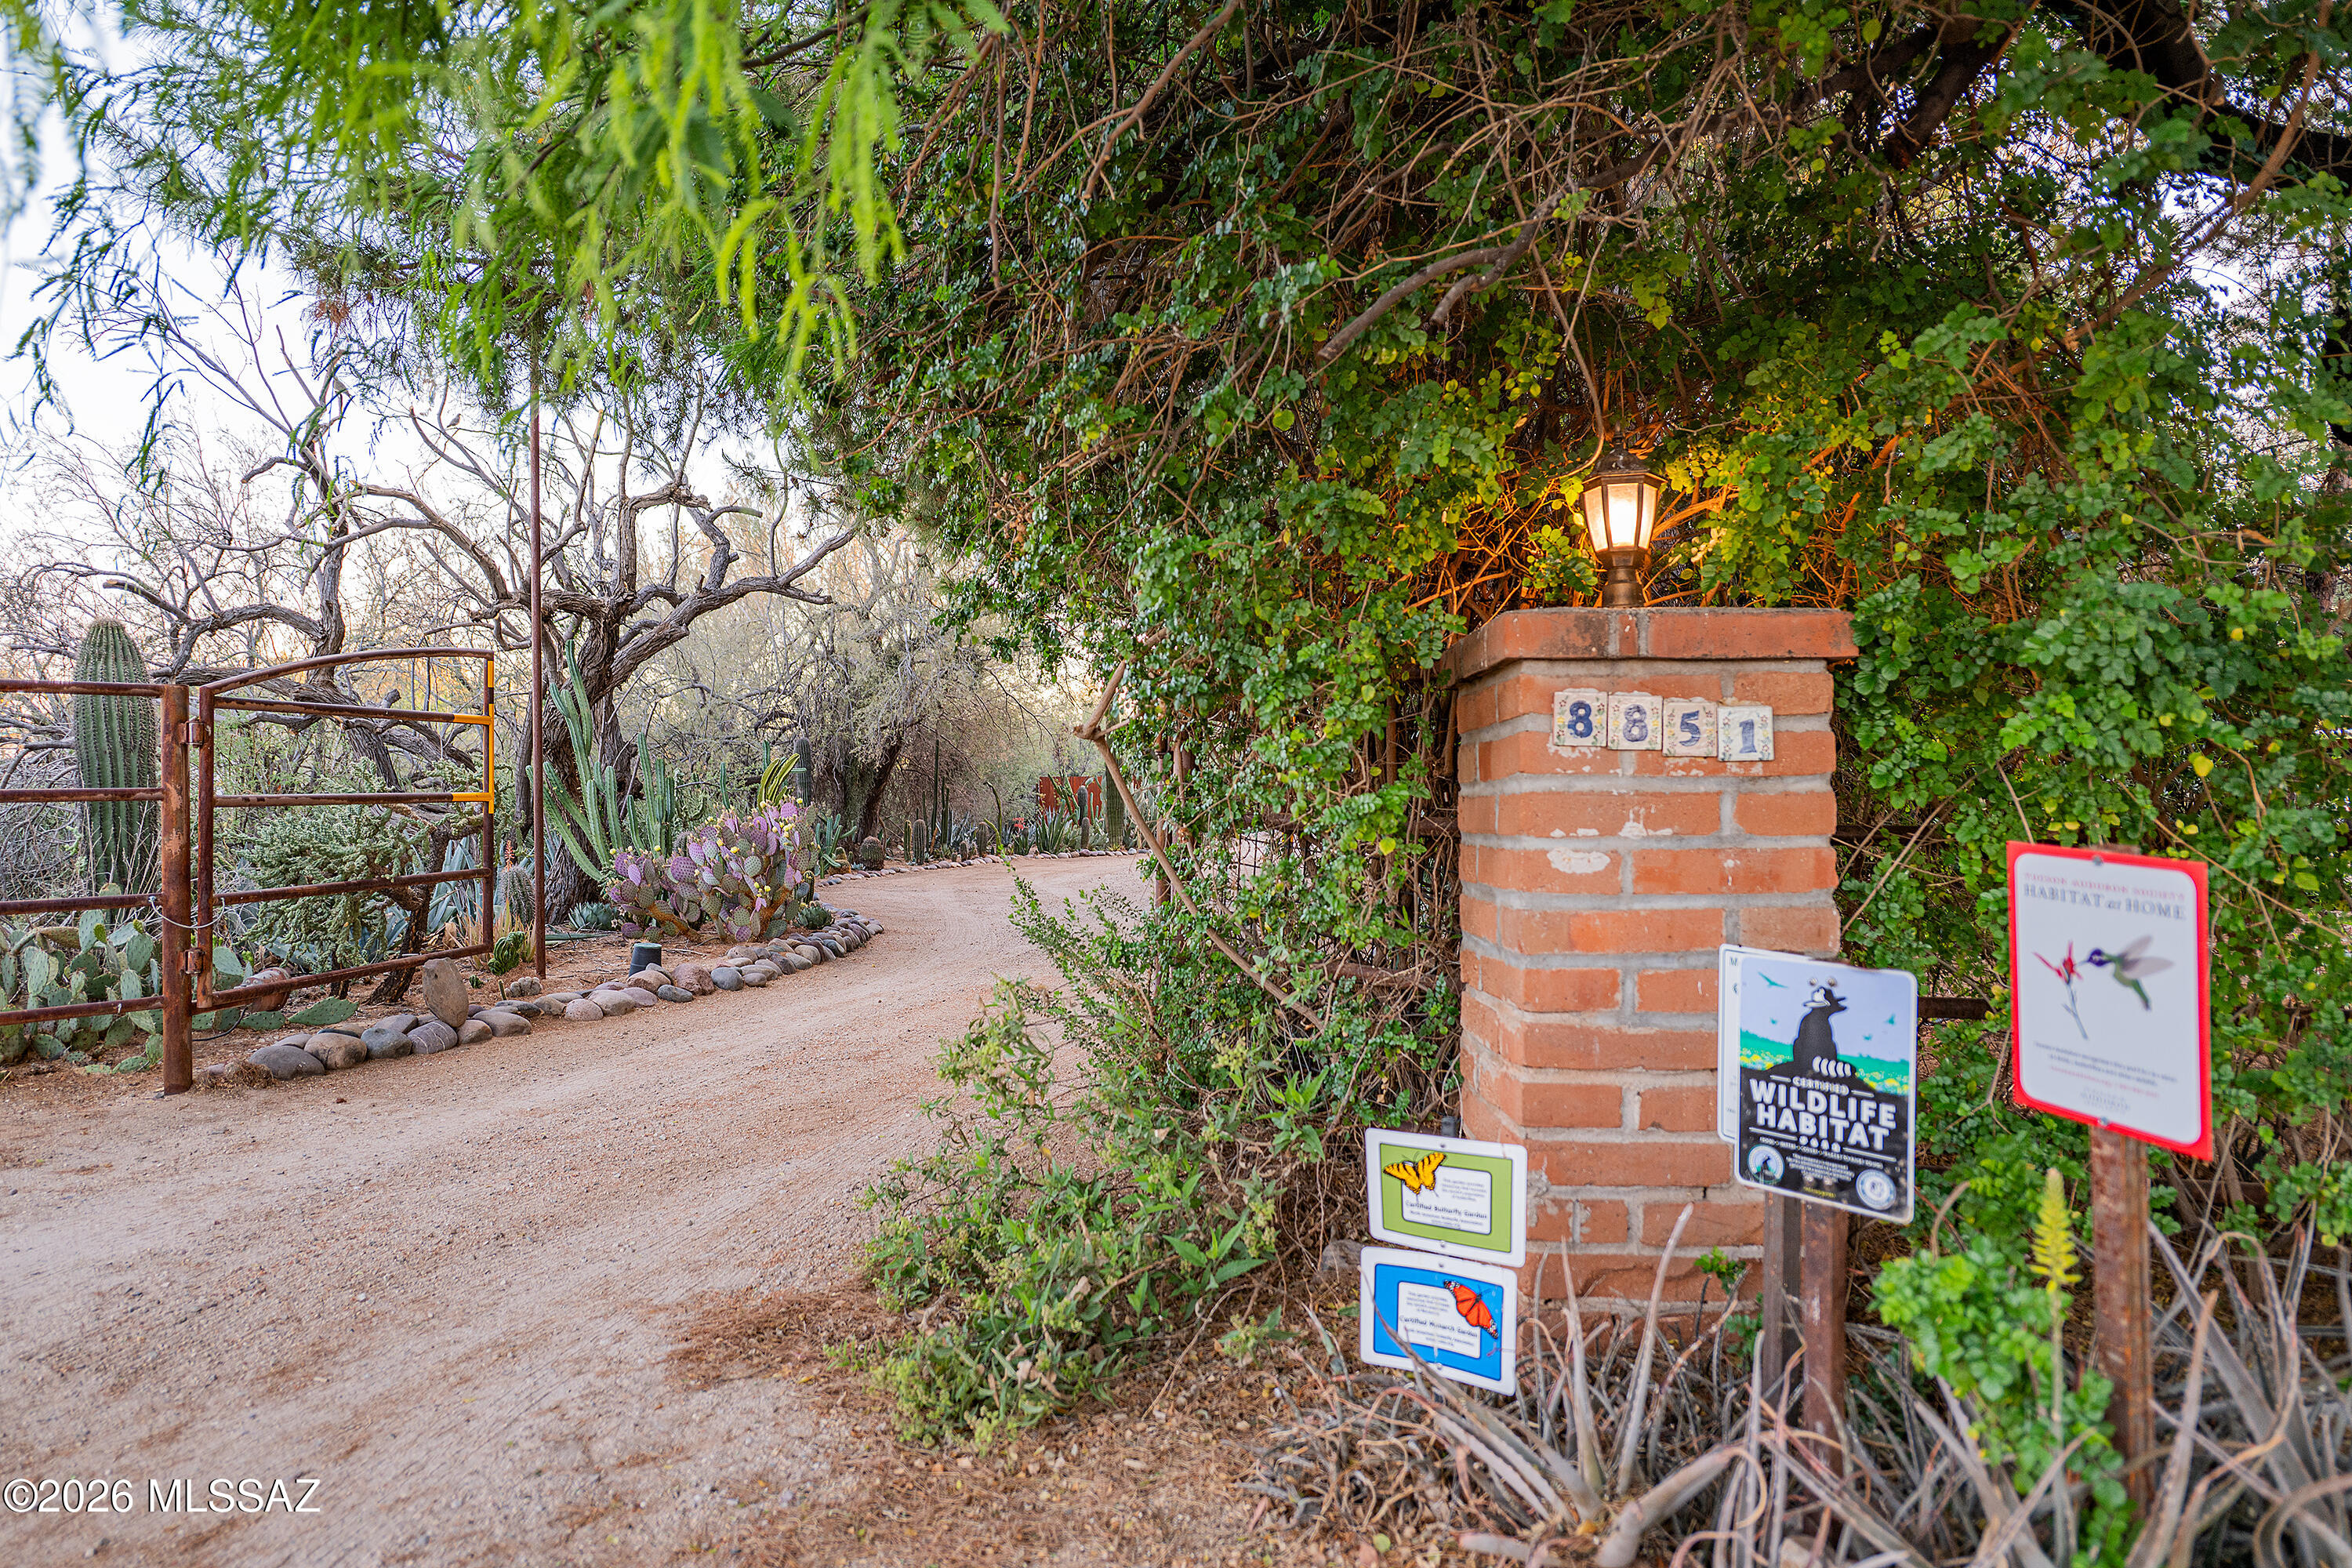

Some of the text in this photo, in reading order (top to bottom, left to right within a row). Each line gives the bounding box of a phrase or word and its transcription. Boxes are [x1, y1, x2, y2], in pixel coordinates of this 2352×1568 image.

[1568, 699, 1758, 754] 8851
[2024, 884, 2104, 908] HABITAT
[2125, 898, 2186, 920] HOME
[1749, 1078, 1897, 1129] WILDLIFE
[1791, 1076, 1850, 1096] CERTIFIED
[1756, 1102, 1890, 1151] HABITAT
[1405, 1200, 1432, 1210] Certified
[1434, 1206, 1462, 1216] Butterfly
[1464, 1210, 1488, 1219] Garden
[1399, 1315, 1428, 1326] Certified
[1429, 1319, 1456, 1332] Monarch
[1456, 1326, 1478, 1338] Garden
